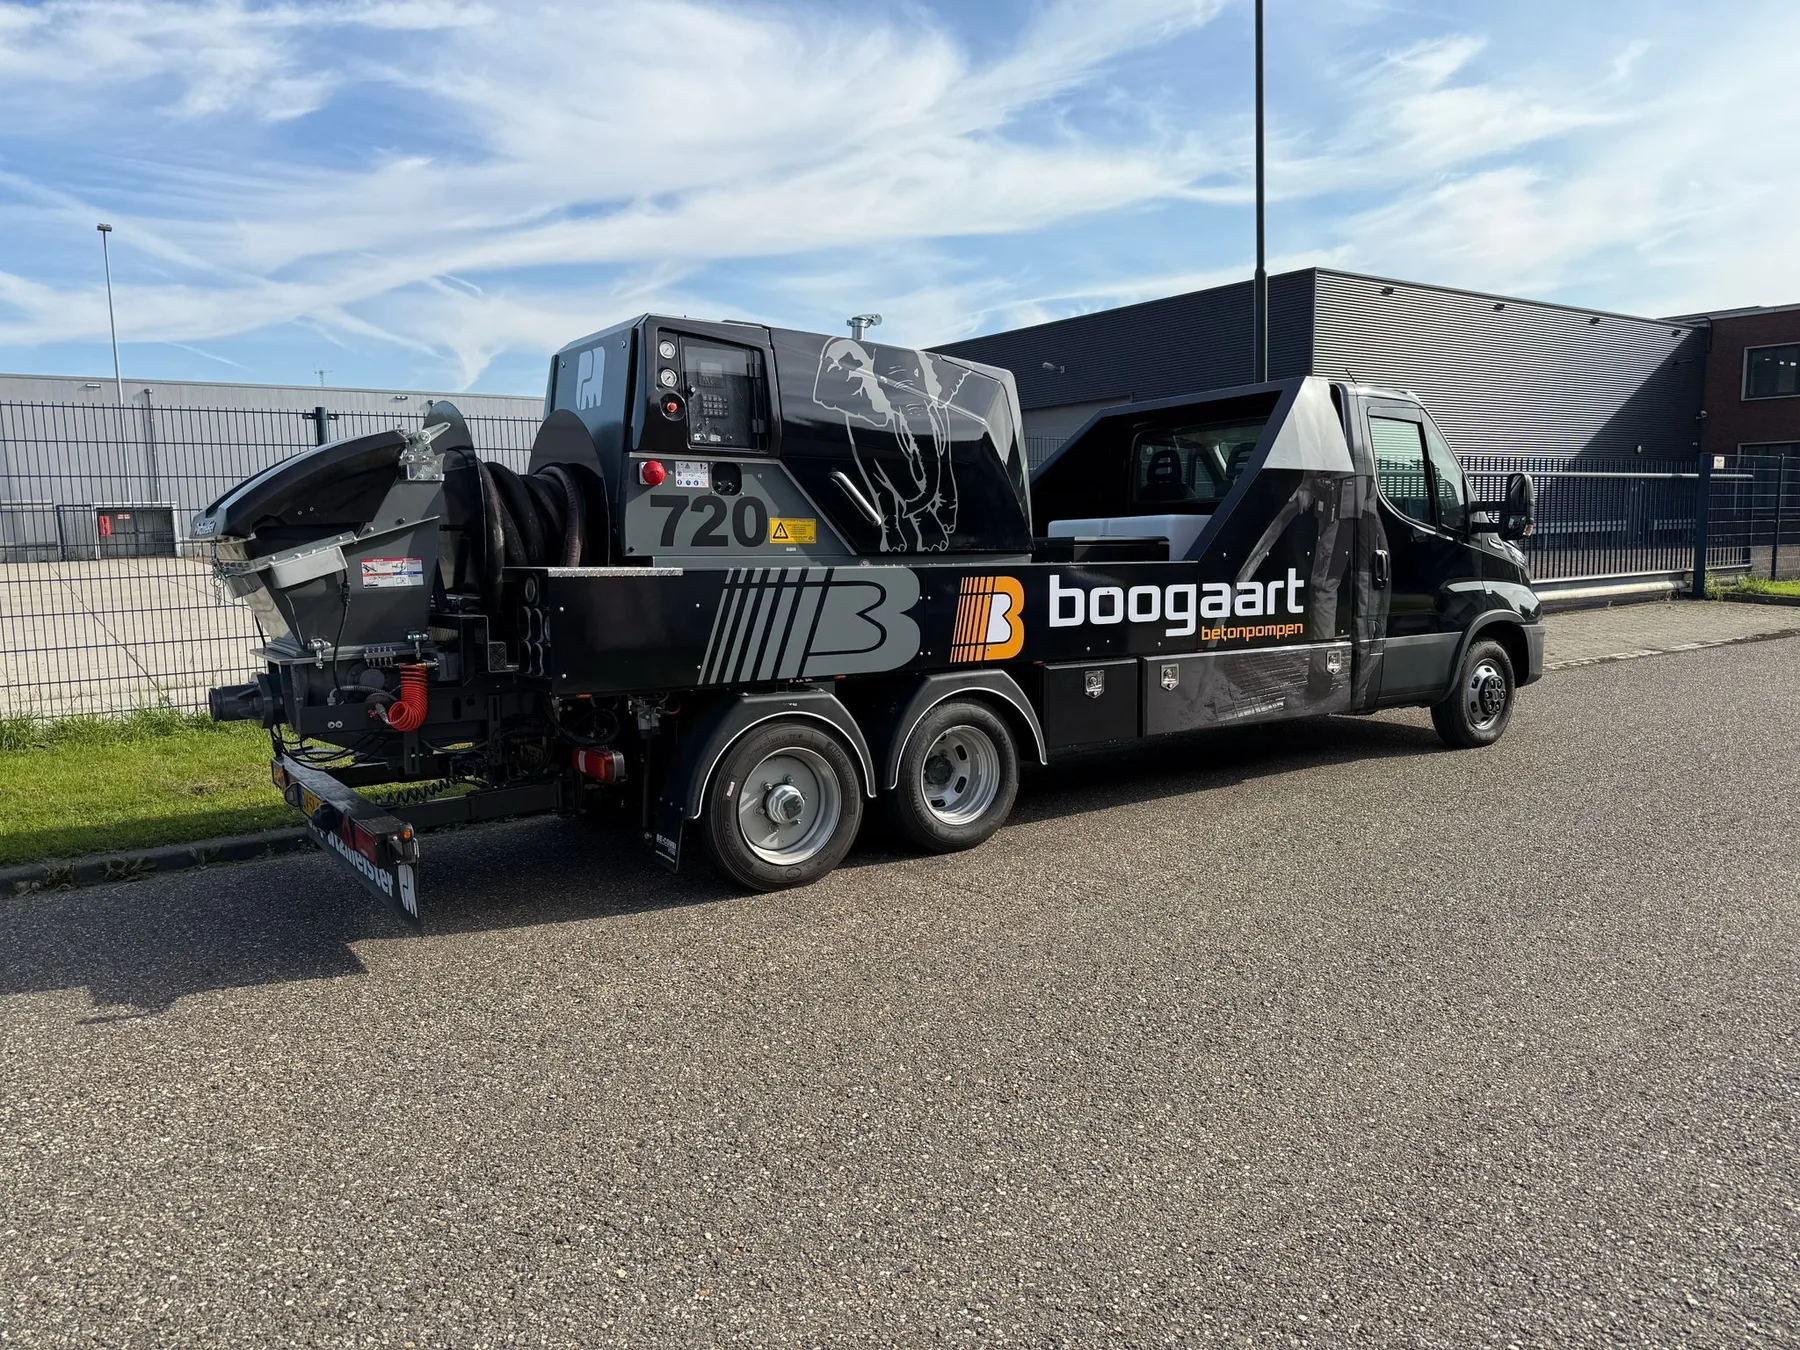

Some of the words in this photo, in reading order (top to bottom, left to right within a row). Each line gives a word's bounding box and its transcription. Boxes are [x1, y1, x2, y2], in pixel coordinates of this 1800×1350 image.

[651, 495, 768, 548] 720
[1050, 567, 1305, 637] boogaart
[1201, 623, 1304, 642] betonpompen
